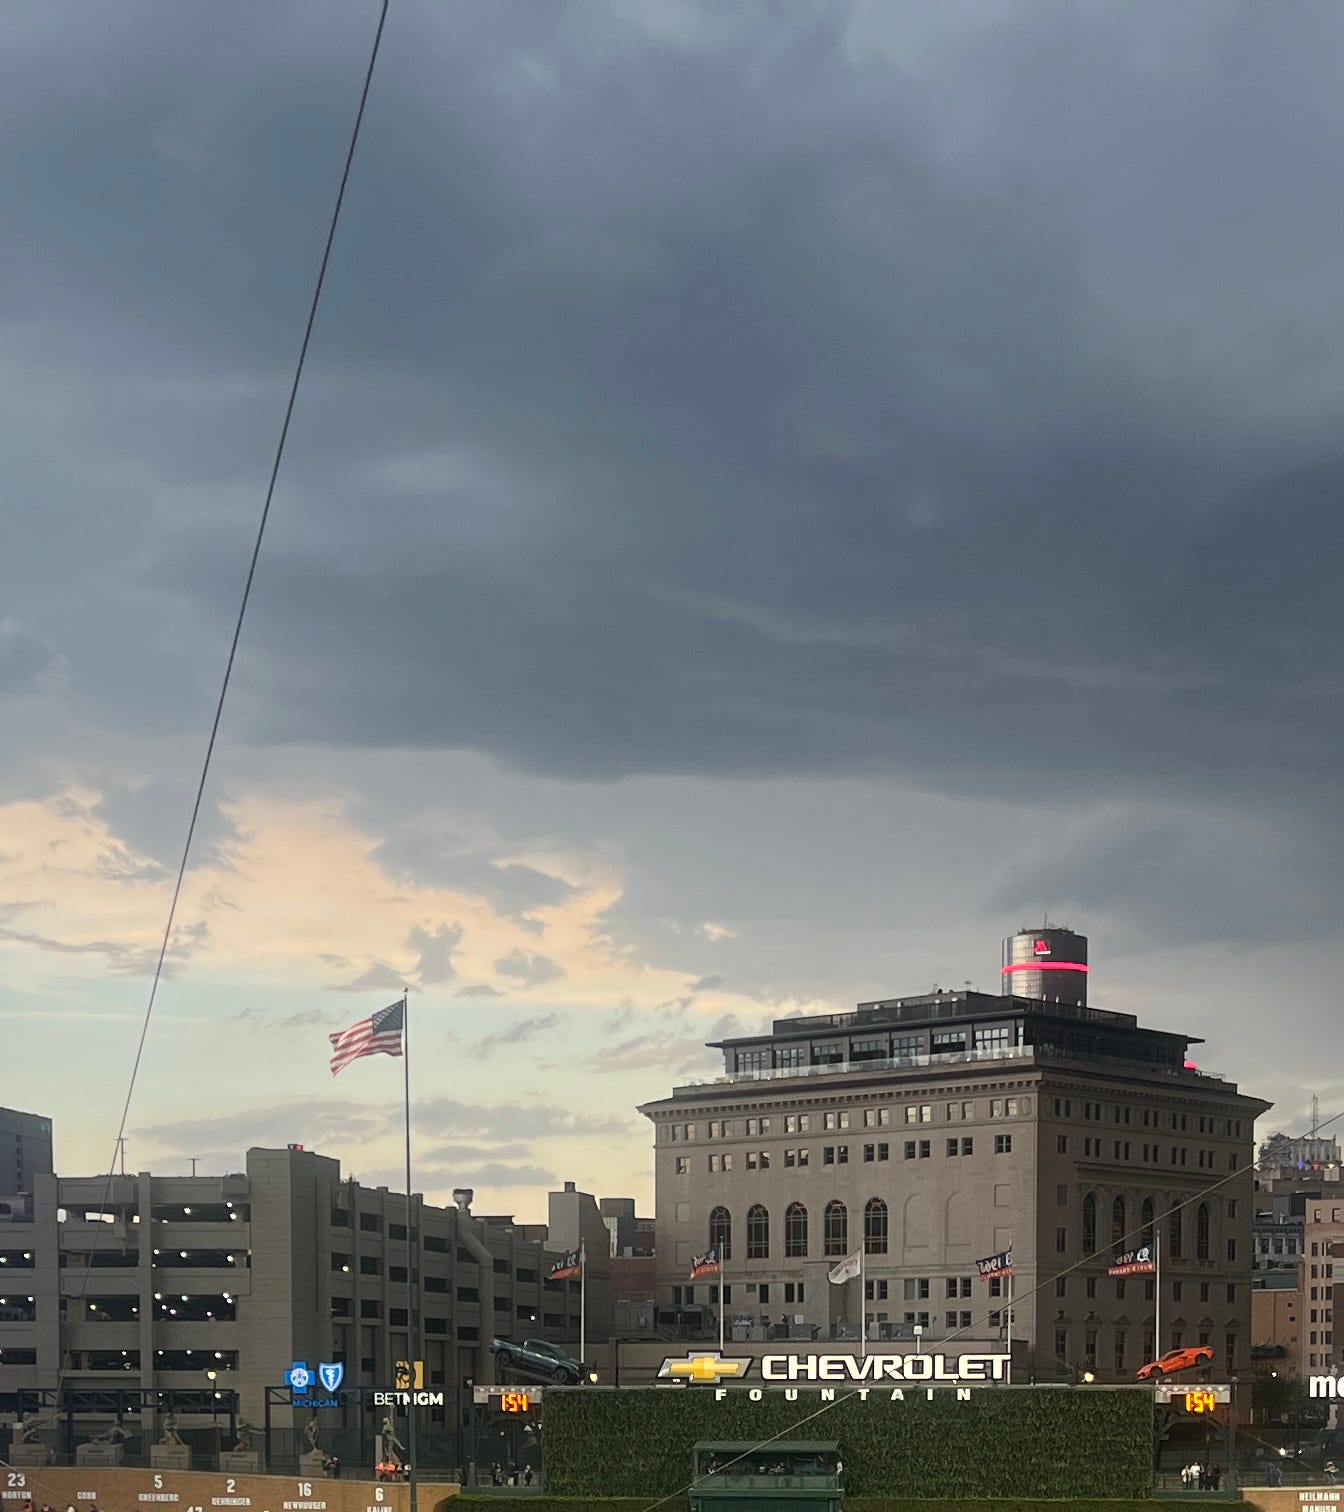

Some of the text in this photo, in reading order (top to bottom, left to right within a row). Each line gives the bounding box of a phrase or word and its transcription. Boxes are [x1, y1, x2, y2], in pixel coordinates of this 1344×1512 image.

[761, 1354, 1011, 1380] CHEVROLET
[715, 1388, 971, 1401] FOUNTAIN
[8, 1473, 26, 1487] 23
[154, 1475, 163, 1489] 5
[226, 1479, 236, 1493] 2
[297, 1482, 312, 1497] 16
[375, 1487, 384, 1501] 6
